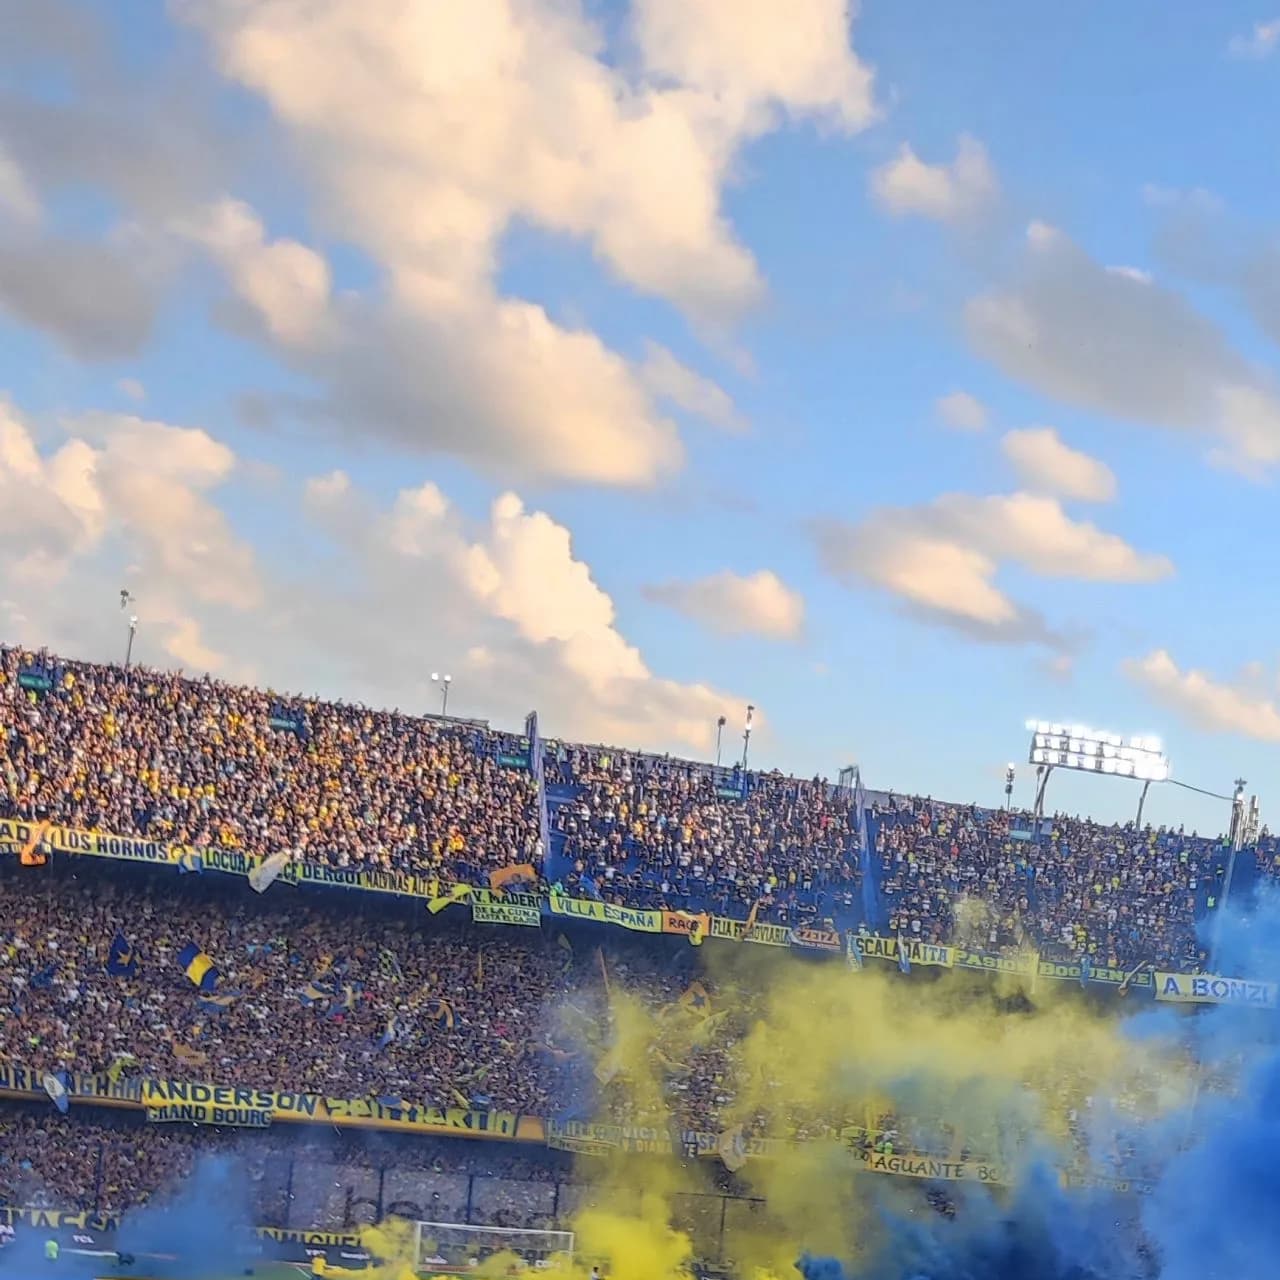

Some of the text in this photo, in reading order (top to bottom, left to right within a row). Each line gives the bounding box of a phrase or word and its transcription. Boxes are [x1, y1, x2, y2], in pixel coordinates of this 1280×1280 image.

[60, 830, 168, 861] LOS HORNOS
[206, 851, 255, 874] LOCURA
[489, 907, 504, 915] LA
[507, 908, 539, 918] CUNA
[557, 898, 655, 928] VILLA ESPAÑA
[856, 937, 921, 960] SCALADA
[147, 1078, 319, 1117] ANDERSON
[213, 1107, 273, 1126] BOURG
[874, 1155, 965, 1178] AGUANTE
